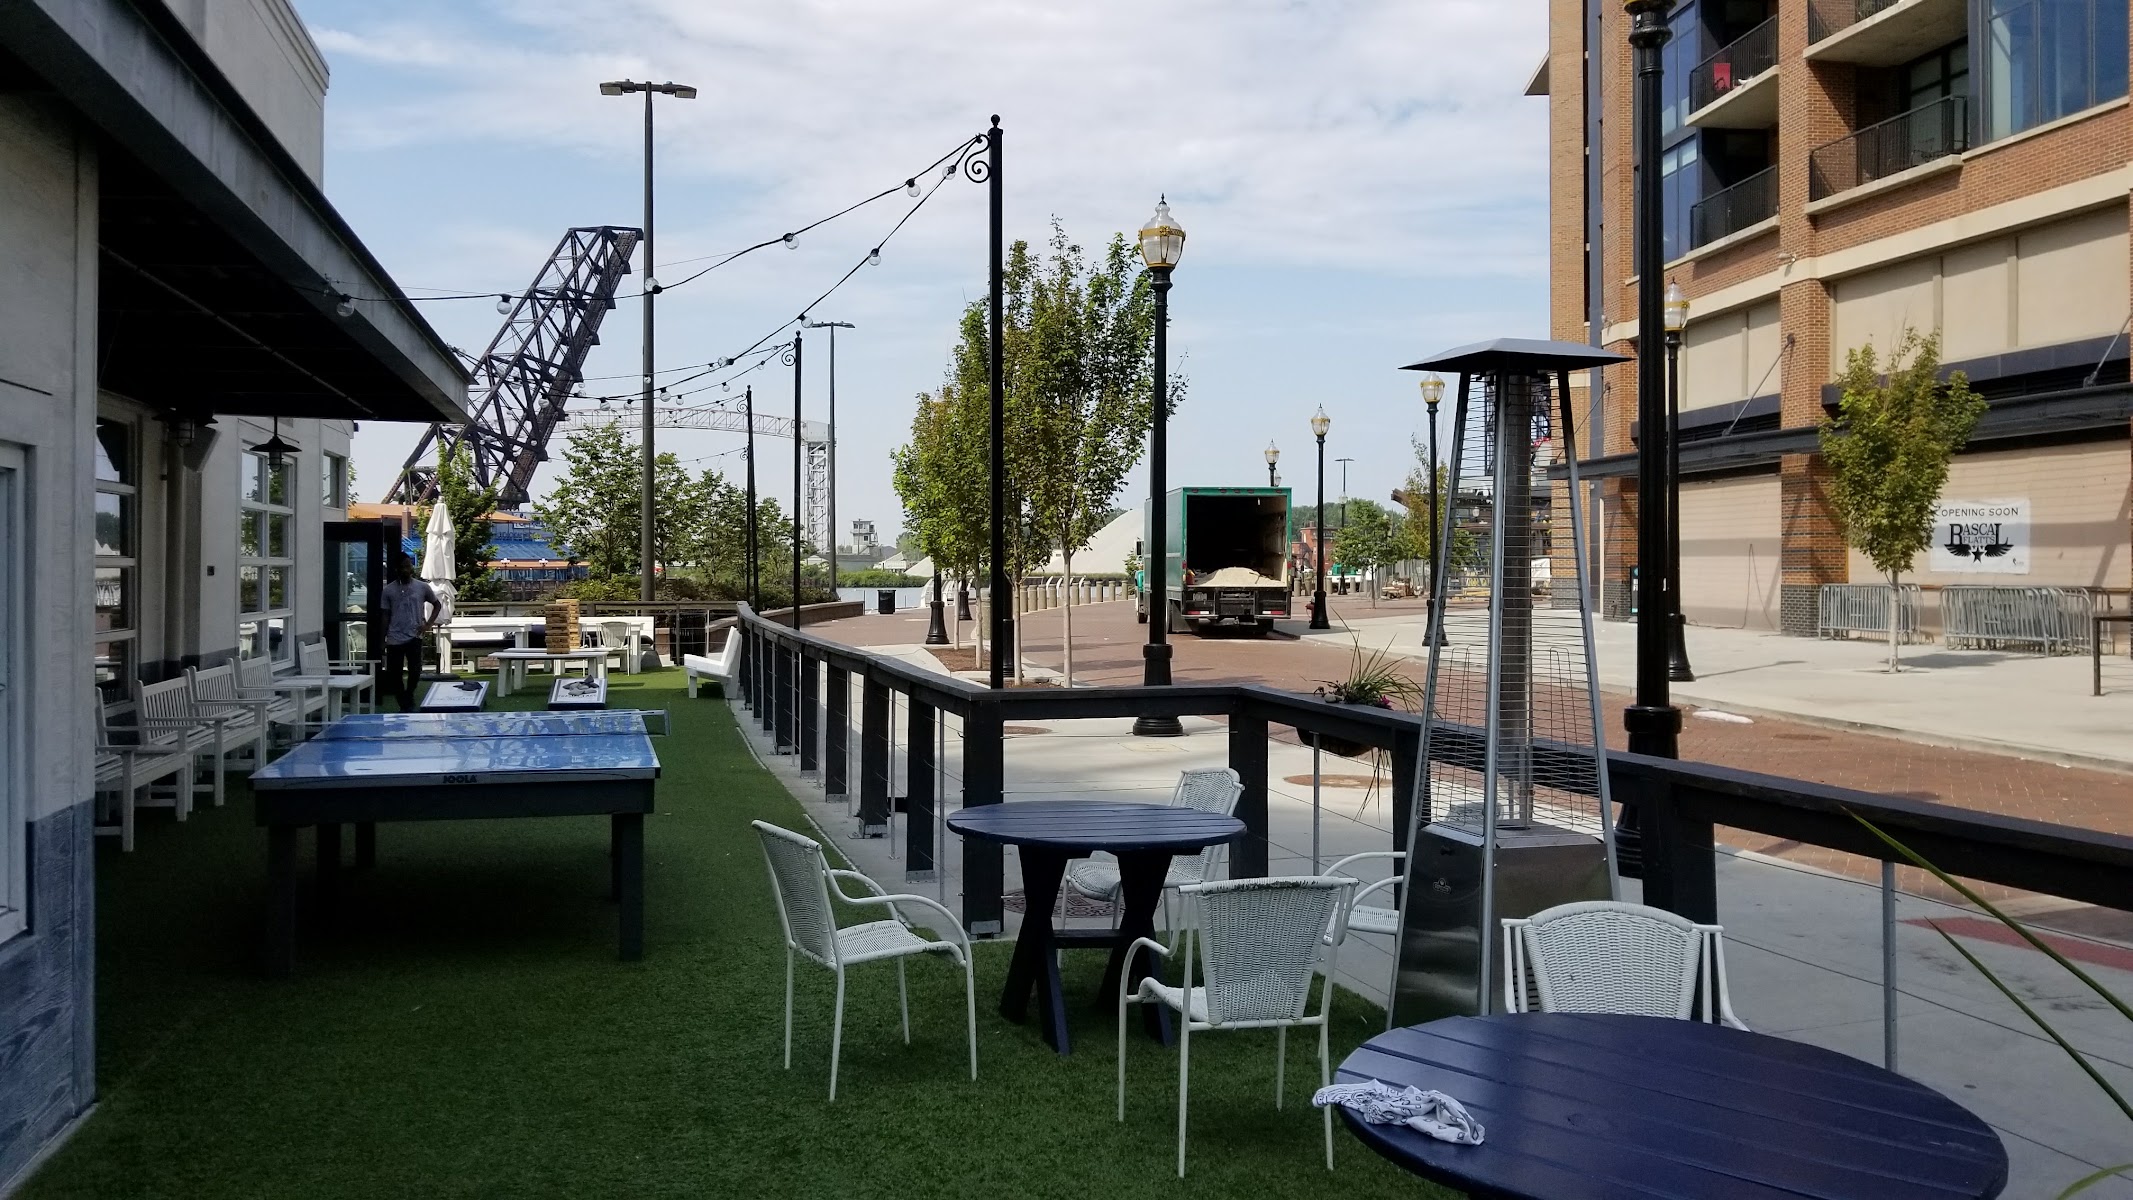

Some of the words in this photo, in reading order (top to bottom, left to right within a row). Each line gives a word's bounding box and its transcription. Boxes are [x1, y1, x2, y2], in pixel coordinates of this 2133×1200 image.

[1941, 508, 1985, 517] OPENING
[1989, 507, 2019, 517] SOON
[1949, 523, 2009, 546] RASCAL
[1963, 536, 1996, 544] FLATTS
[443, 774, 478, 784] JOOLA
